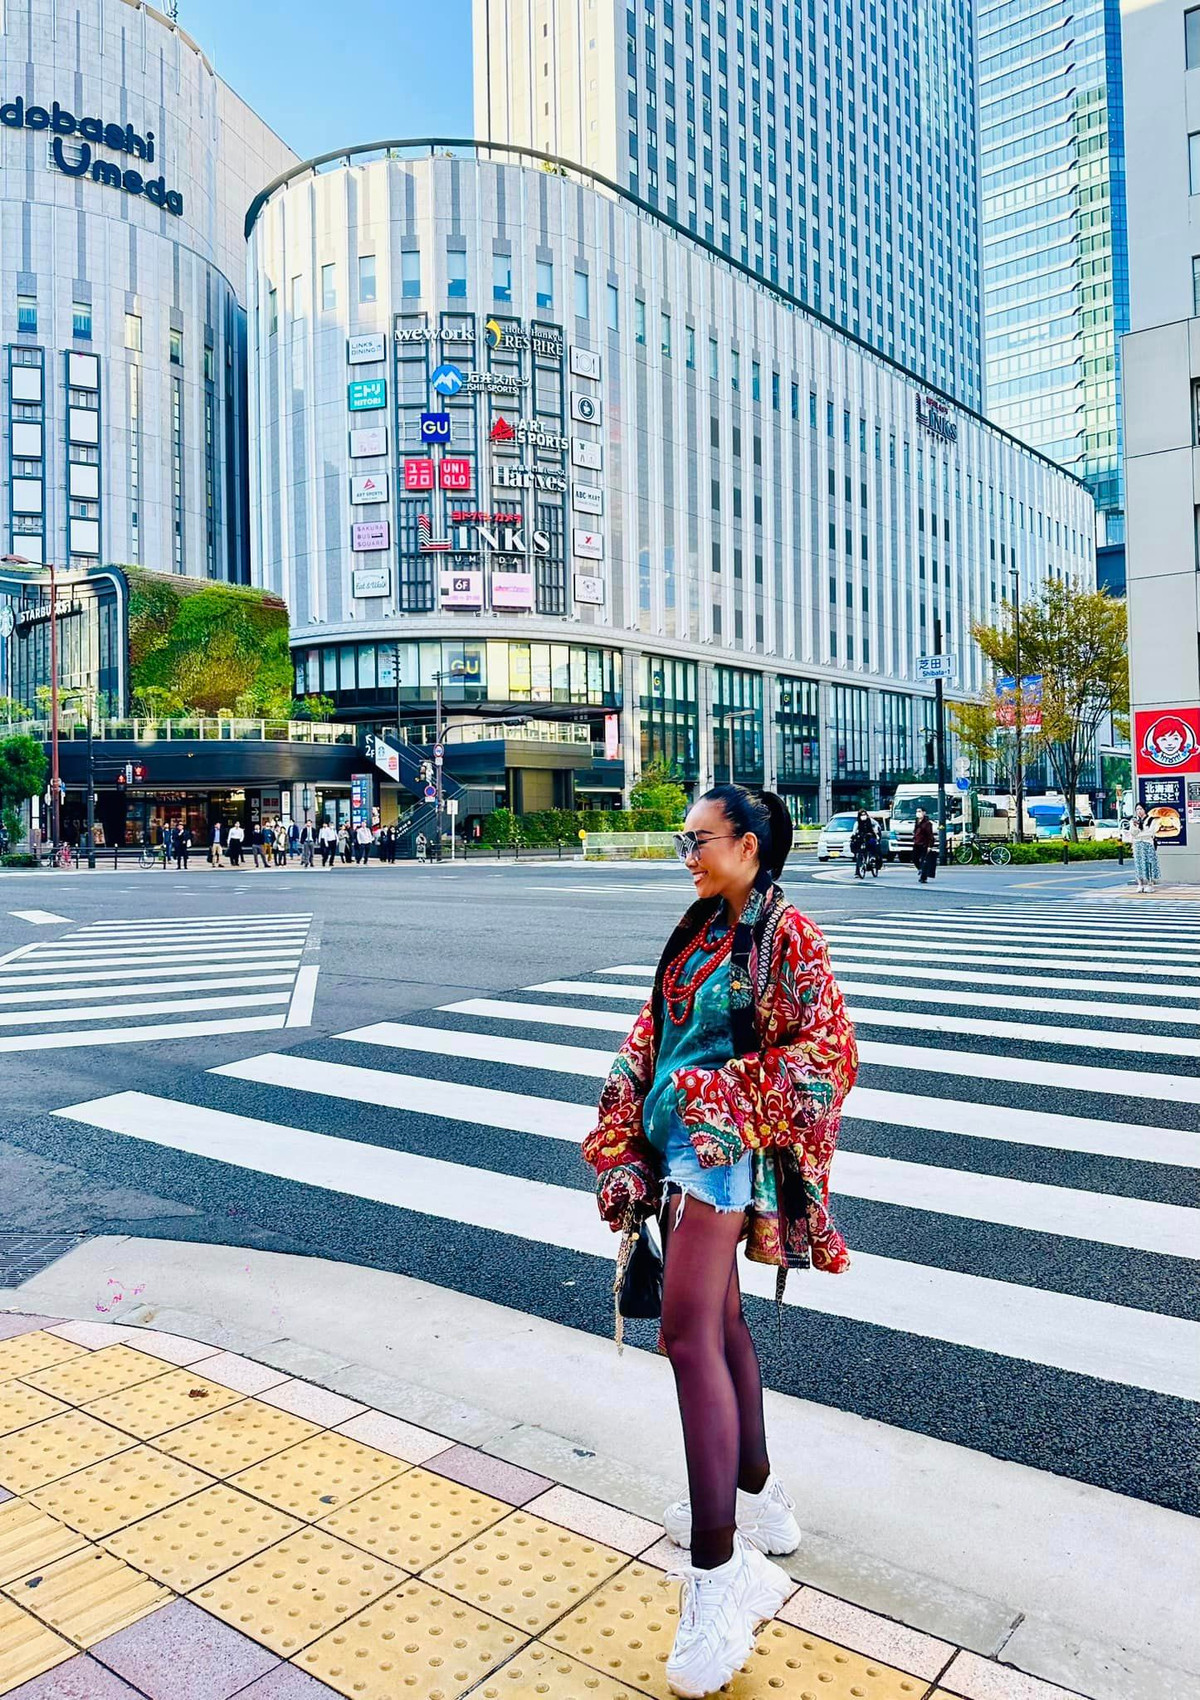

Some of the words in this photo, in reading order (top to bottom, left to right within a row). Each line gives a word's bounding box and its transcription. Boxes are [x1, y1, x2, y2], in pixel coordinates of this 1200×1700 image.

[53, 137, 183, 216] Umeda
[394, 322, 475, 341] wework
[505, 335, 564, 355] RESPIRE
[466, 371, 531, 387] 石井スポーツ
[353, 382, 381, 397] ニトリ
[487, 384, 520, 394] SPORTS
[422, 420, 448, 435] GU
[517, 418, 546, 433] ART
[517, 430, 569, 450] SPORTS
[408, 462, 430, 474] ユニ
[443, 462, 464, 474] UNI
[408, 474, 430, 486] クロ
[443, 474, 466, 487] QLO
[418, 514, 550, 553] LINKS
[455, 579, 469, 590] 6F
[20, 600, 71, 622] STARBUKS
[451, 659, 479, 675] GU
[919, 659, 941, 670] 芝田
[946, 657, 951, 667] 1
[365, 745, 375, 757] 2F
